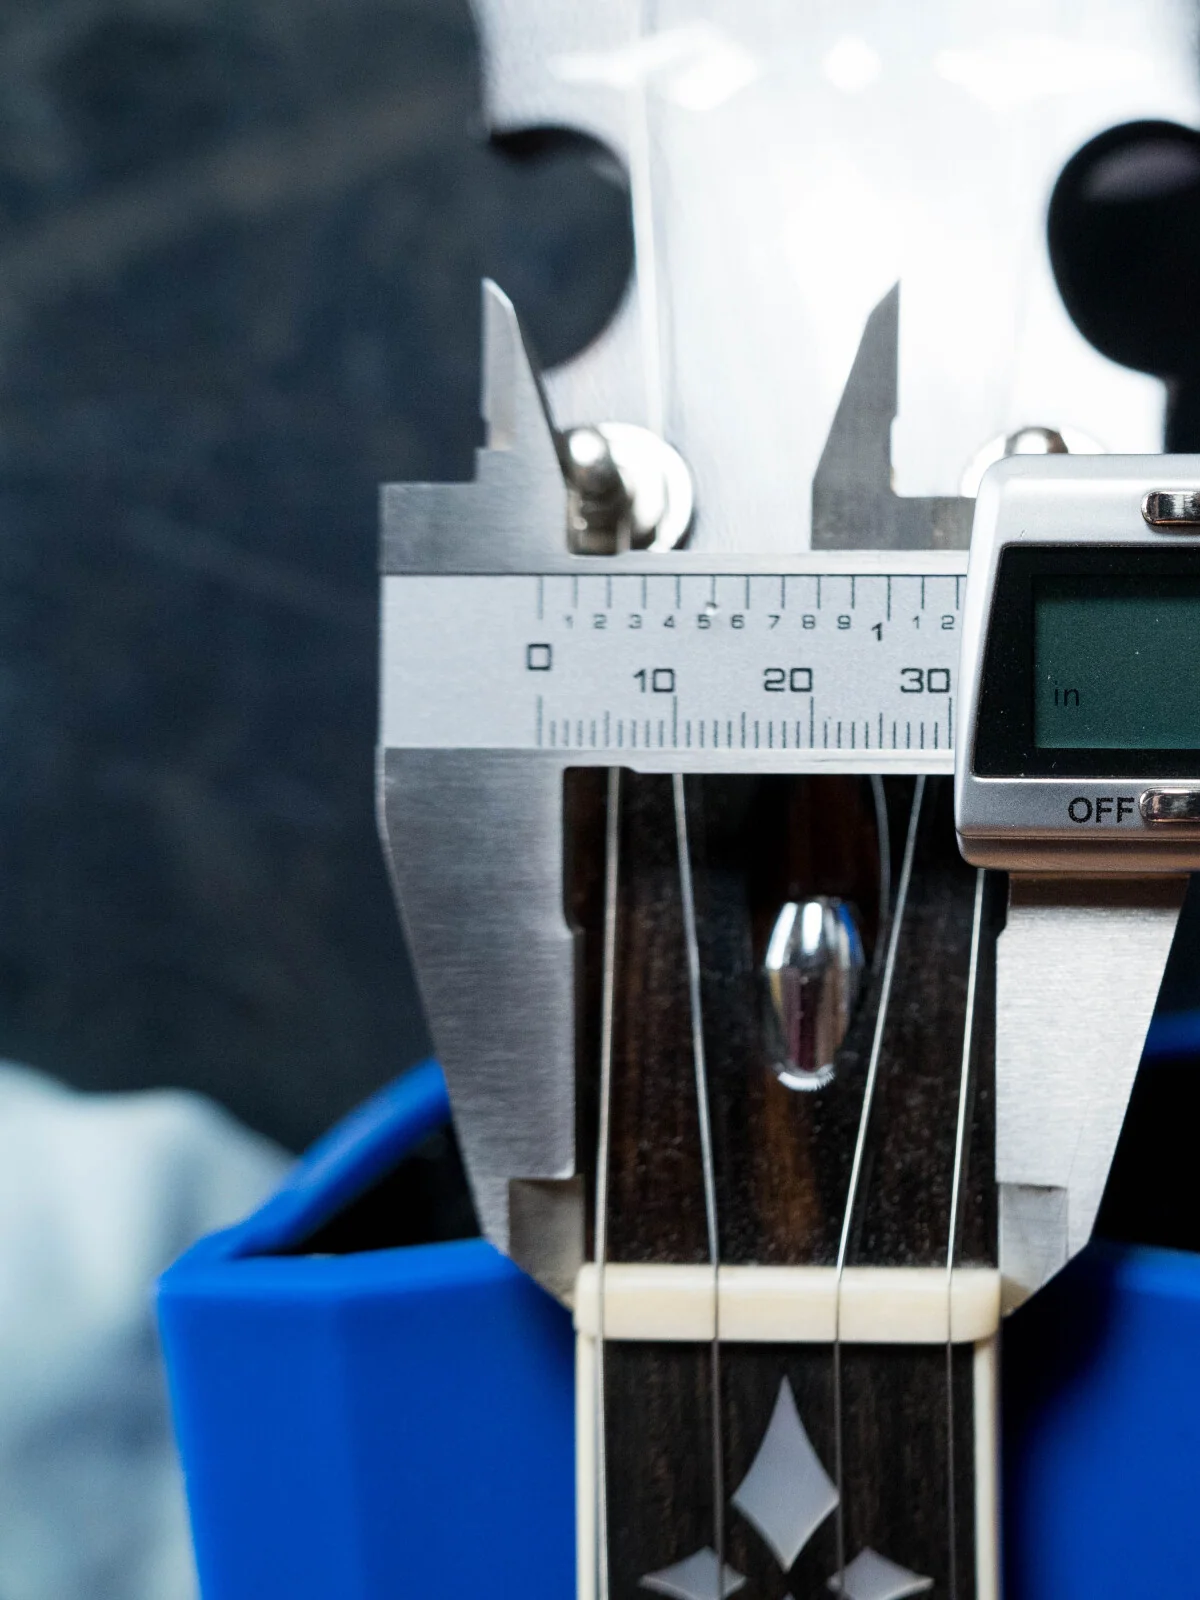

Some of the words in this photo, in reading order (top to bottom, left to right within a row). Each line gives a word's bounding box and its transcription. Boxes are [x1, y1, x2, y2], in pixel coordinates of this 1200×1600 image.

[593, 613, 608, 630] 2
[628, 613, 643, 630] 3
[663, 614, 676, 629] 4
[697, 613, 711, 630] 5
[730, 614, 744, 630] 6
[768, 614, 781, 630] 7
[801, 614, 816, 630] 8
[836, 614, 852, 630] 9
[871, 622, 883, 642] 1
[940, 614, 955, 631] 2
[526, 643, 553, 672] 0
[633, 668, 676, 694] 10
[763, 667, 813, 693] 20
[900, 667, 951, 694] 30
[1054, 681, 1081, 707] in
[1067, 796, 1135, 824] OFF
